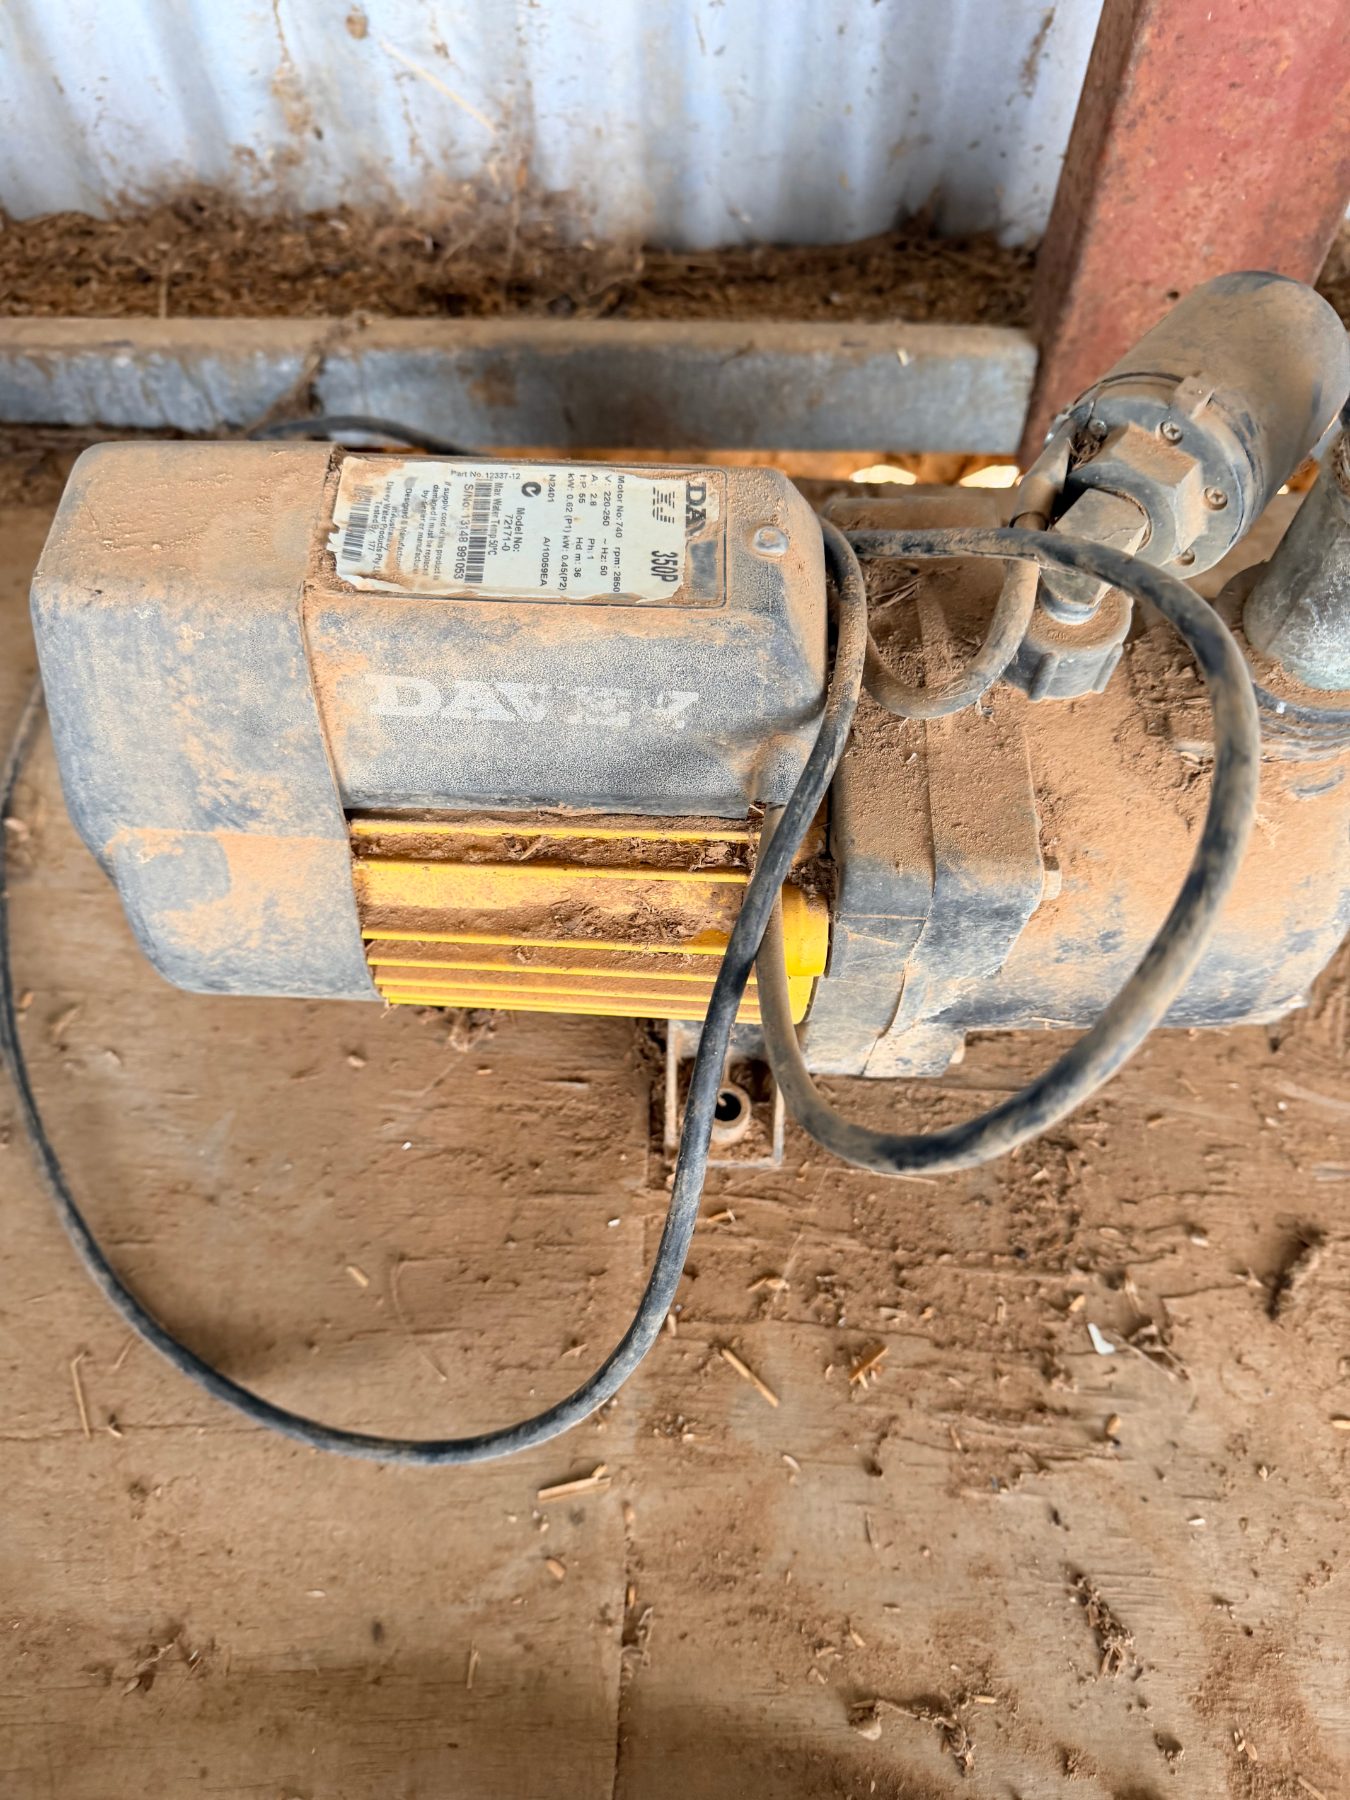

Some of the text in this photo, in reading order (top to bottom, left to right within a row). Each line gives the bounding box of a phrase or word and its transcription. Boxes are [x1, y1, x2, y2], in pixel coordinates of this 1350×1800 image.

[451, 469, 467, 477] Part
[493, 482, 504, 496] Max
[578, 493, 586, 504] 55
[492, 498, 502, 518] Water
[602, 491, 610, 526] 220-250
[454, 483, 473, 579] S/No: 13148 991053
[488, 520, 501, 539] Temp
[502, 514, 513, 551] 72171-0
[513, 507, 526, 552] Model No:
[540, 474, 556, 586] N2401 A/10059EA
[557, 473, 575, 591] kW: 0.62 (P1) kW: 0.45(P2)
[613, 475, 625, 592] Motor No: 740 rpm: 2850
[367, 541, 376, 551] 177
[575, 537, 583, 550] Hd
[434, 549, 444, 574] product
[575, 553, 581, 564] m:
[651, 551, 678, 582] 350P
[574, 567, 581, 578] 36
[600, 565, 607, 576] 50
